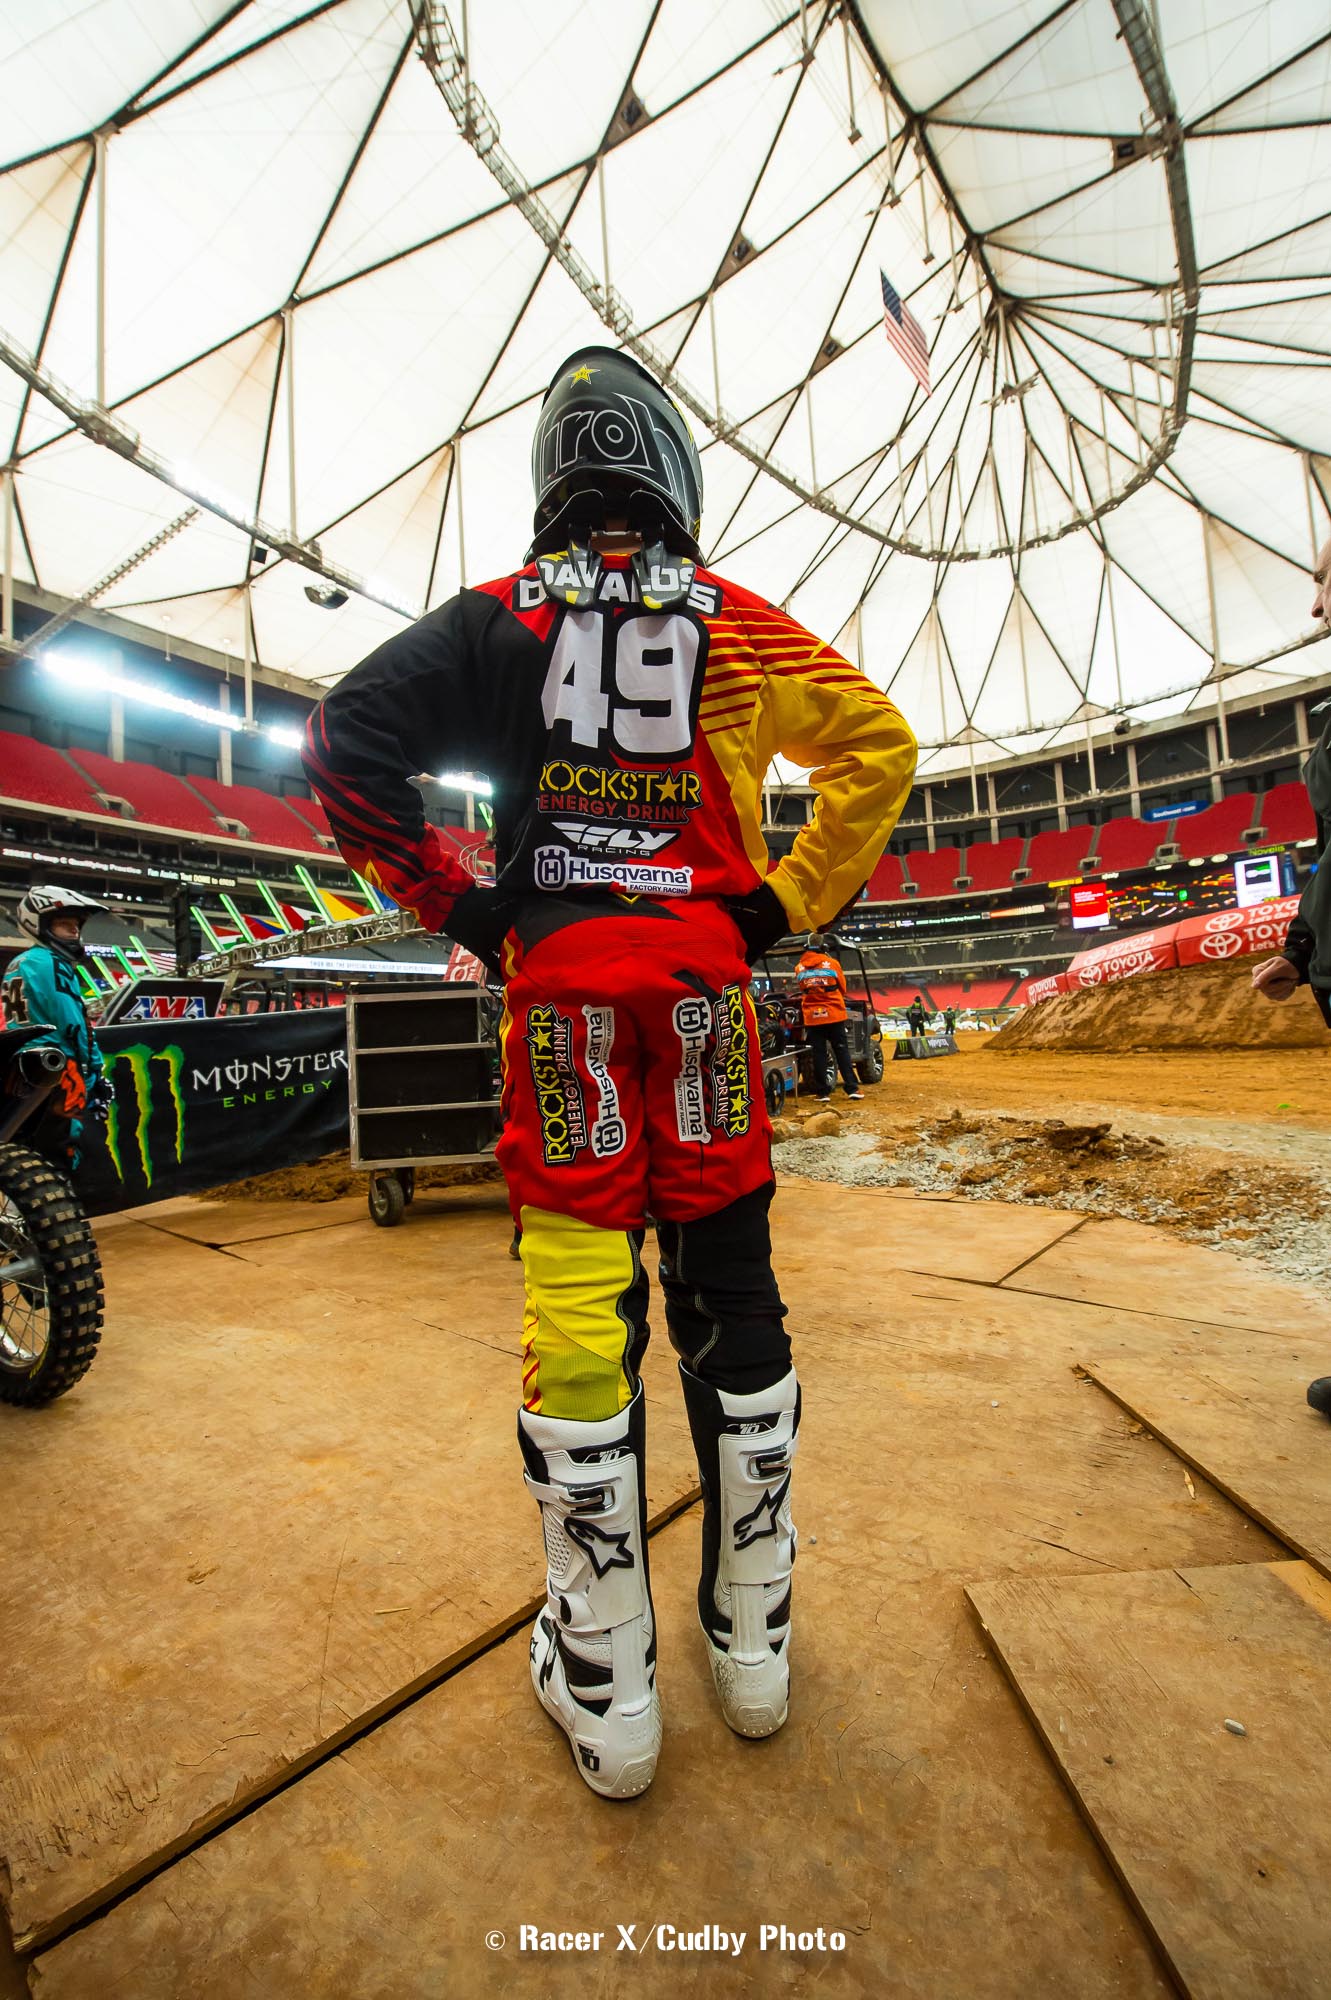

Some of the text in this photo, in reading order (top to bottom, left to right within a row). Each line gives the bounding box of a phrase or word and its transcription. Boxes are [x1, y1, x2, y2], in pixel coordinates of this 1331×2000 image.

[541, 611, 700, 754] 49
[539, 794, 688, 822] ENERGY DRINK
[551, 822, 678, 851] FLY
[577, 844, 651, 858] RACING
[568, 859, 689, 886] Husqvarna
[629, 884, 688, 895] FACTORY RACING
[1248, 899, 1300, 920] TOYO
[1243, 920, 1291, 942] TOY
[1102, 951, 1154, 974] TOYOTA
[120, 996, 209, 1020] AMA
[192, 1049, 349, 1093] MONSTER
[588, 1012, 617, 1121] Husqvarna
[715, 1004, 731, 1123] ENERGY DRINK
[727, 987, 748, 1134] ROCKSTAR
[223, 1079, 333, 1109] ENERGY
[531, 1009, 571, 1160] ROCKSTAR
[553, 1022, 584, 1147] ENERGY DRINK
[683, 1035, 704, 1136] Husqvarna
